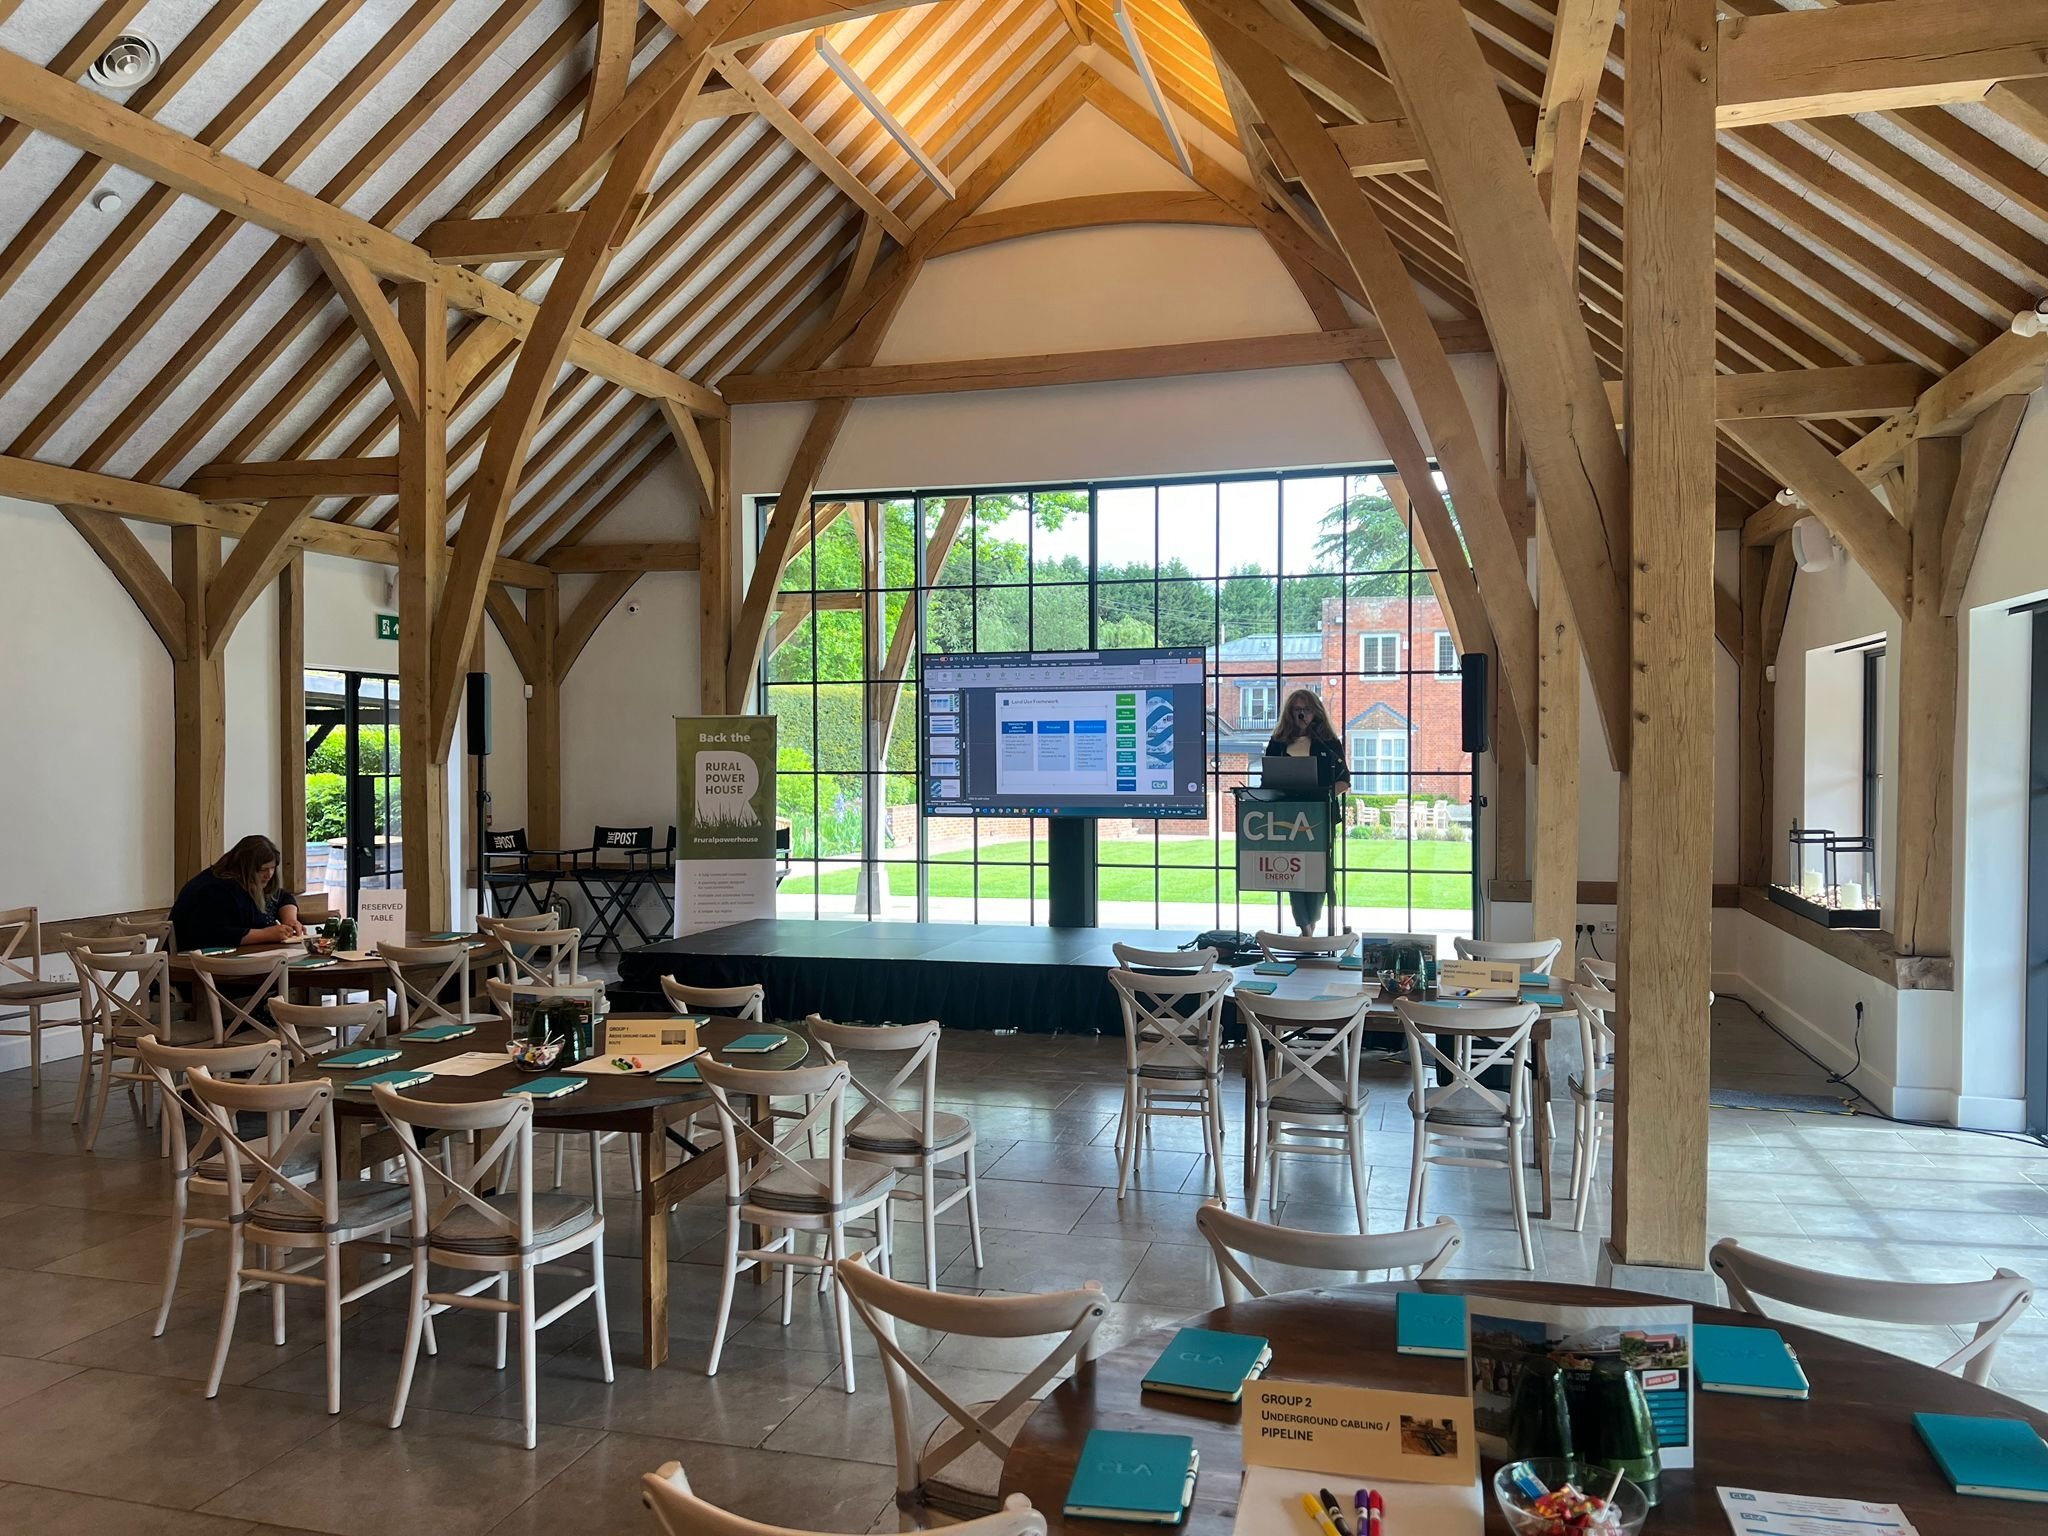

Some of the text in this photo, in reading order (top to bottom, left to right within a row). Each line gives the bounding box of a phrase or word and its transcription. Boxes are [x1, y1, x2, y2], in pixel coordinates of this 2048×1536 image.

[699, 732, 751, 743] Back the
[705, 762, 741, 771] RURAL
[705, 774, 745, 783] POWER
[705, 785, 744, 795] HOUSE
[1242, 811, 1315, 841] CLA
[500, 835, 516, 848] POST
[606, 832, 638, 845] THE POST
[1259, 857, 1301, 873] ILOS
[361, 903, 403, 911] RESERVED
[370, 914, 394, 922] TABLE
[1179, 1351, 1224, 1365] CLA
[1261, 1393, 1312, 1408] GROUP 2
[1261, 1410, 1391, 1432] UNDERGROUND CABLING /
[1261, 1427, 1313, 1442] PIPELINE
